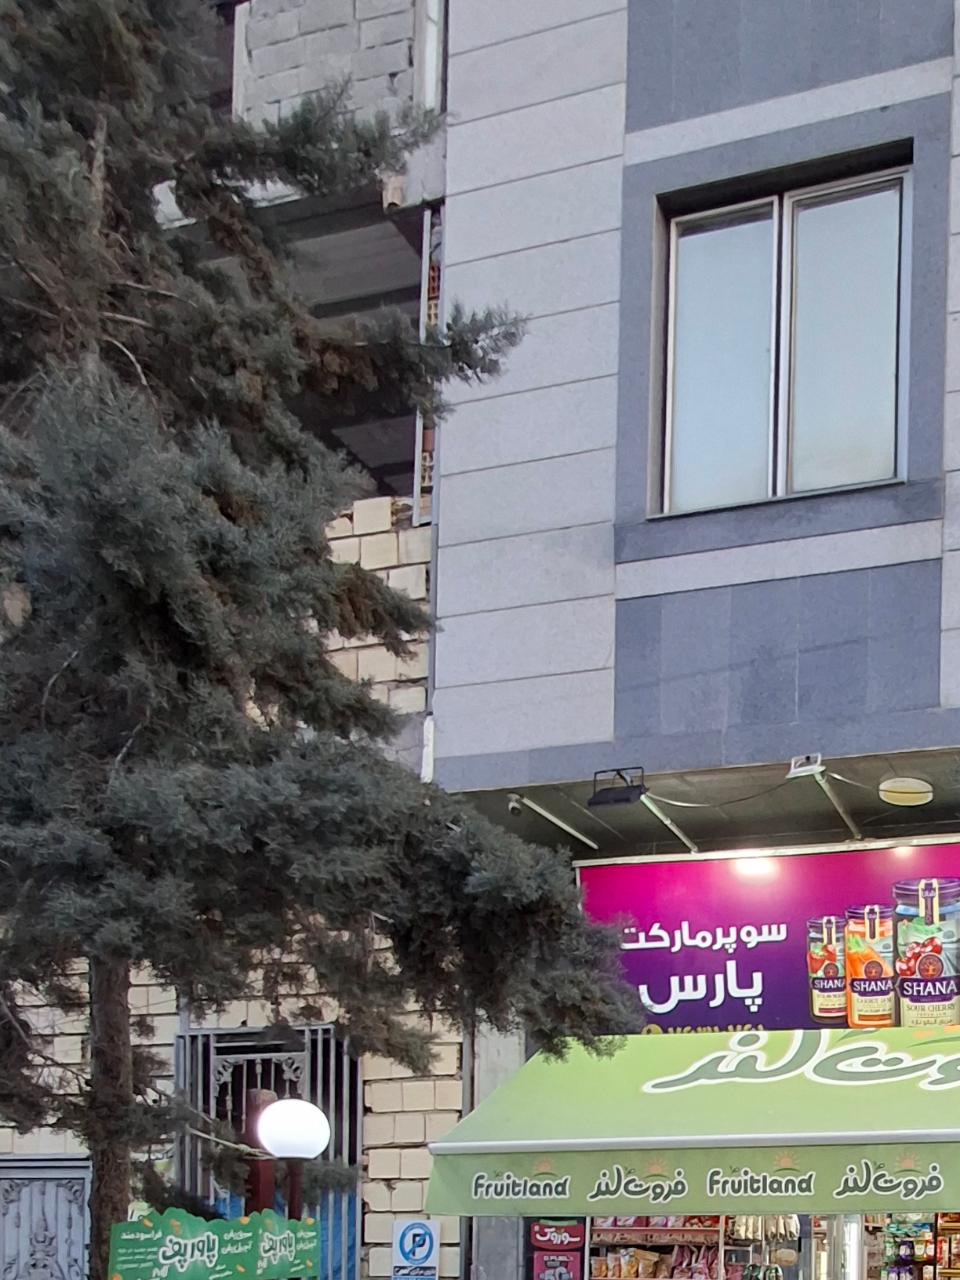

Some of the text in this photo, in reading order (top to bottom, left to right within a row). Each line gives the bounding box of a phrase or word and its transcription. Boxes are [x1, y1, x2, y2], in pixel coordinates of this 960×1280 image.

[620, 921, 787, 953] سوپرمارکت
[638, 960, 763, 1012] پارس
[853, 980, 893, 992] SHANA
[903, 981, 958, 996] SHANA
[473, 1172, 571, 1198] Fruitland
[707, 1169, 815, 1196] Fruitland
